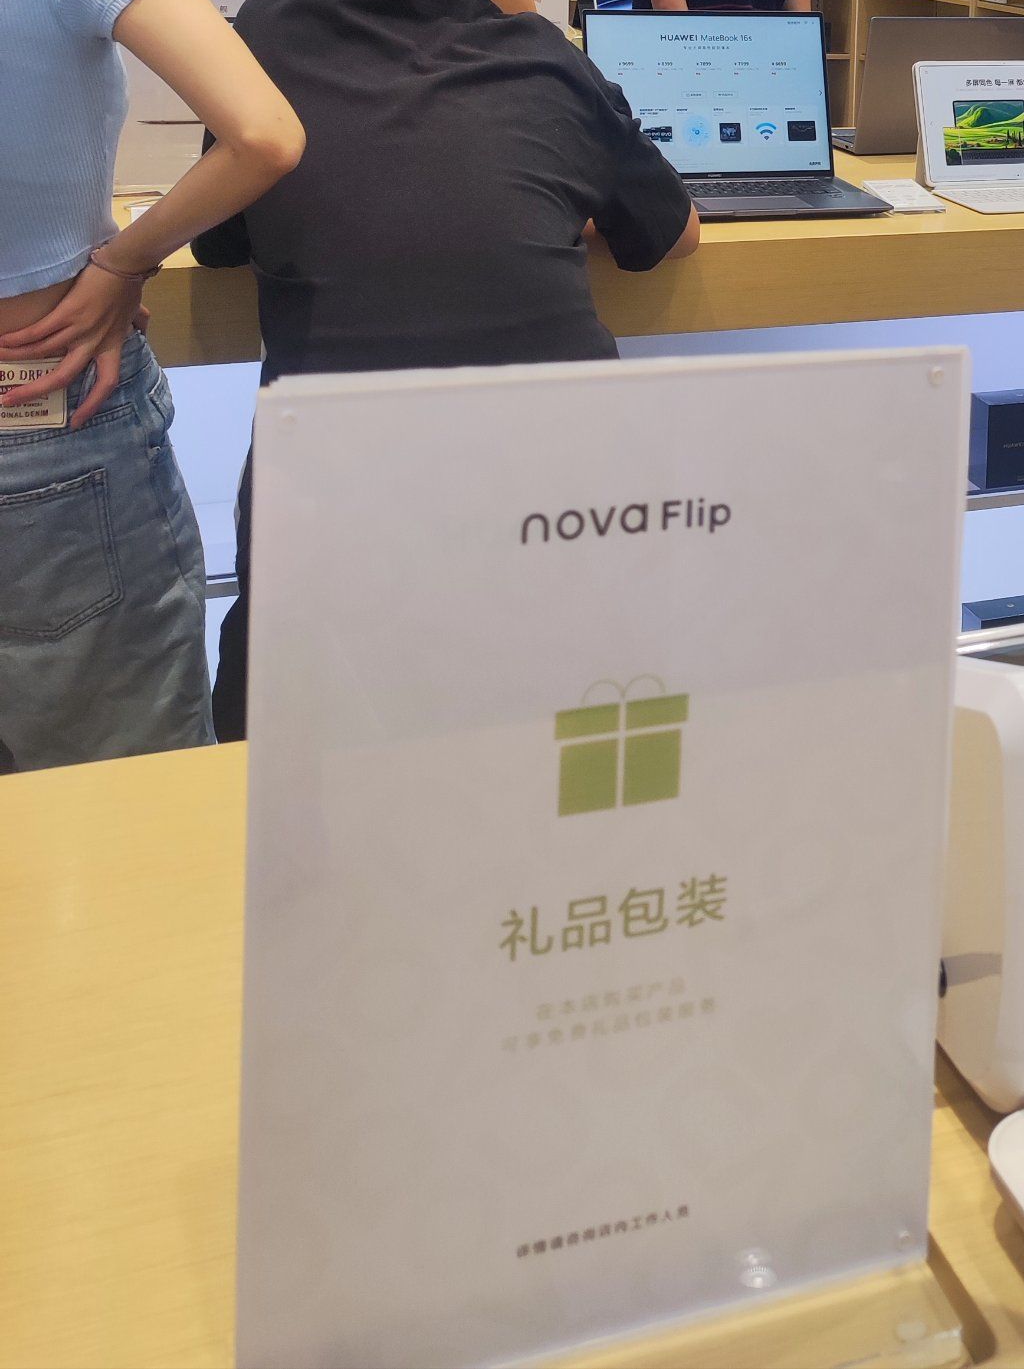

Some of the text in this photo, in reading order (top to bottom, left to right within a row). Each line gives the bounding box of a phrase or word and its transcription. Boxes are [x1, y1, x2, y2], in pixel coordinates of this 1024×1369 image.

[660, 34, 753, 42] HUAWEI MateBook 16s
[520, 498, 732, 544] nova Flip
[499, 872, 728, 962] 礼品包装
